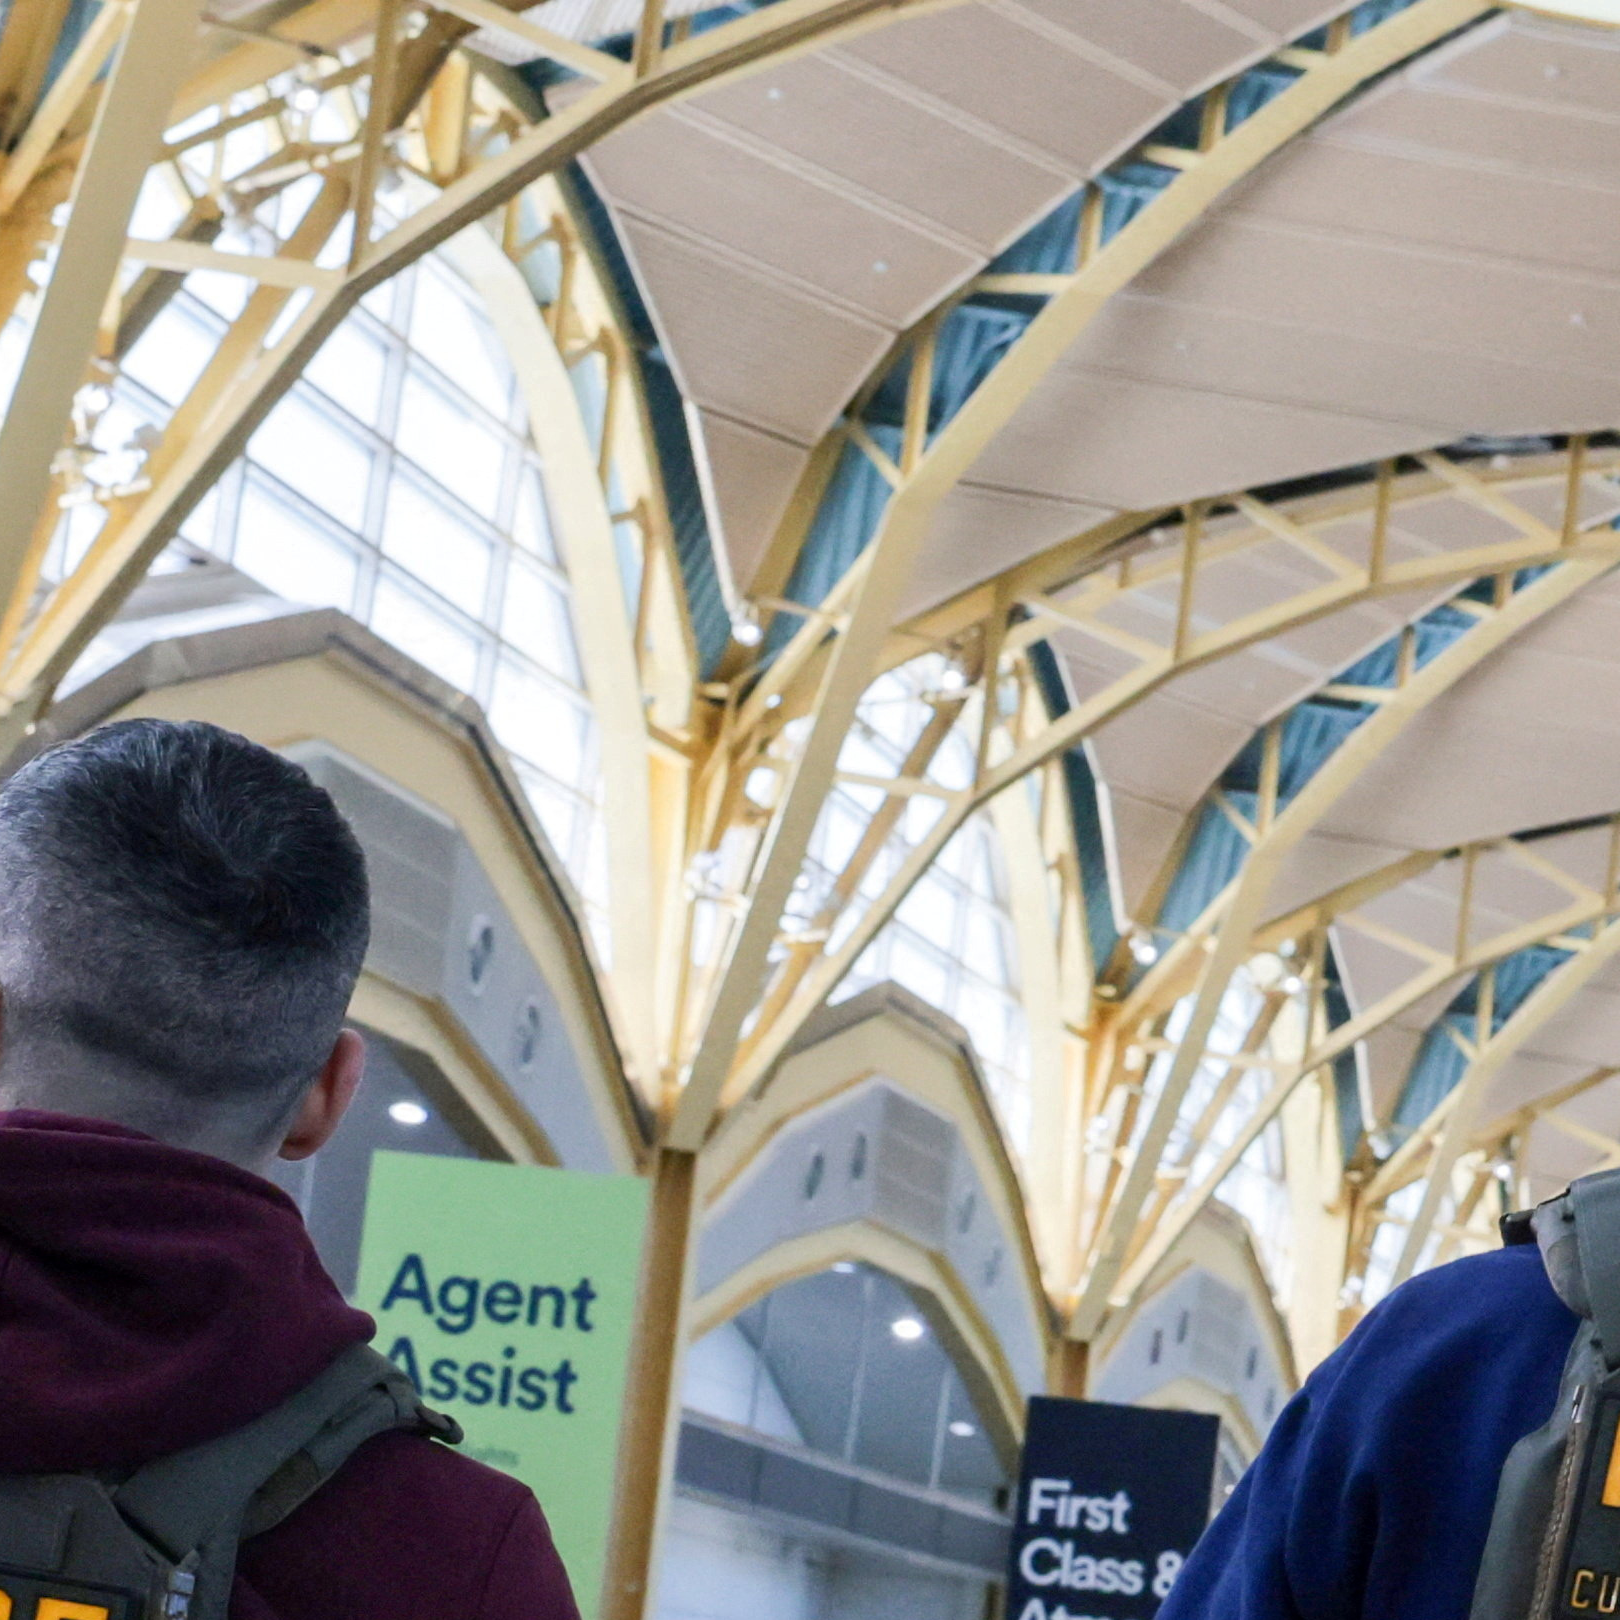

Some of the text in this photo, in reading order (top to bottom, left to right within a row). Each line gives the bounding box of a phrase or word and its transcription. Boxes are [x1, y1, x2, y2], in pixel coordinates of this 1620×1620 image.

[380, 1252, 597, 1334] Agent
[387, 1336, 578, 1413] Assist
[1027, 1477, 1132, 1534] First
[1019, 1536, 1145, 1596] Class
